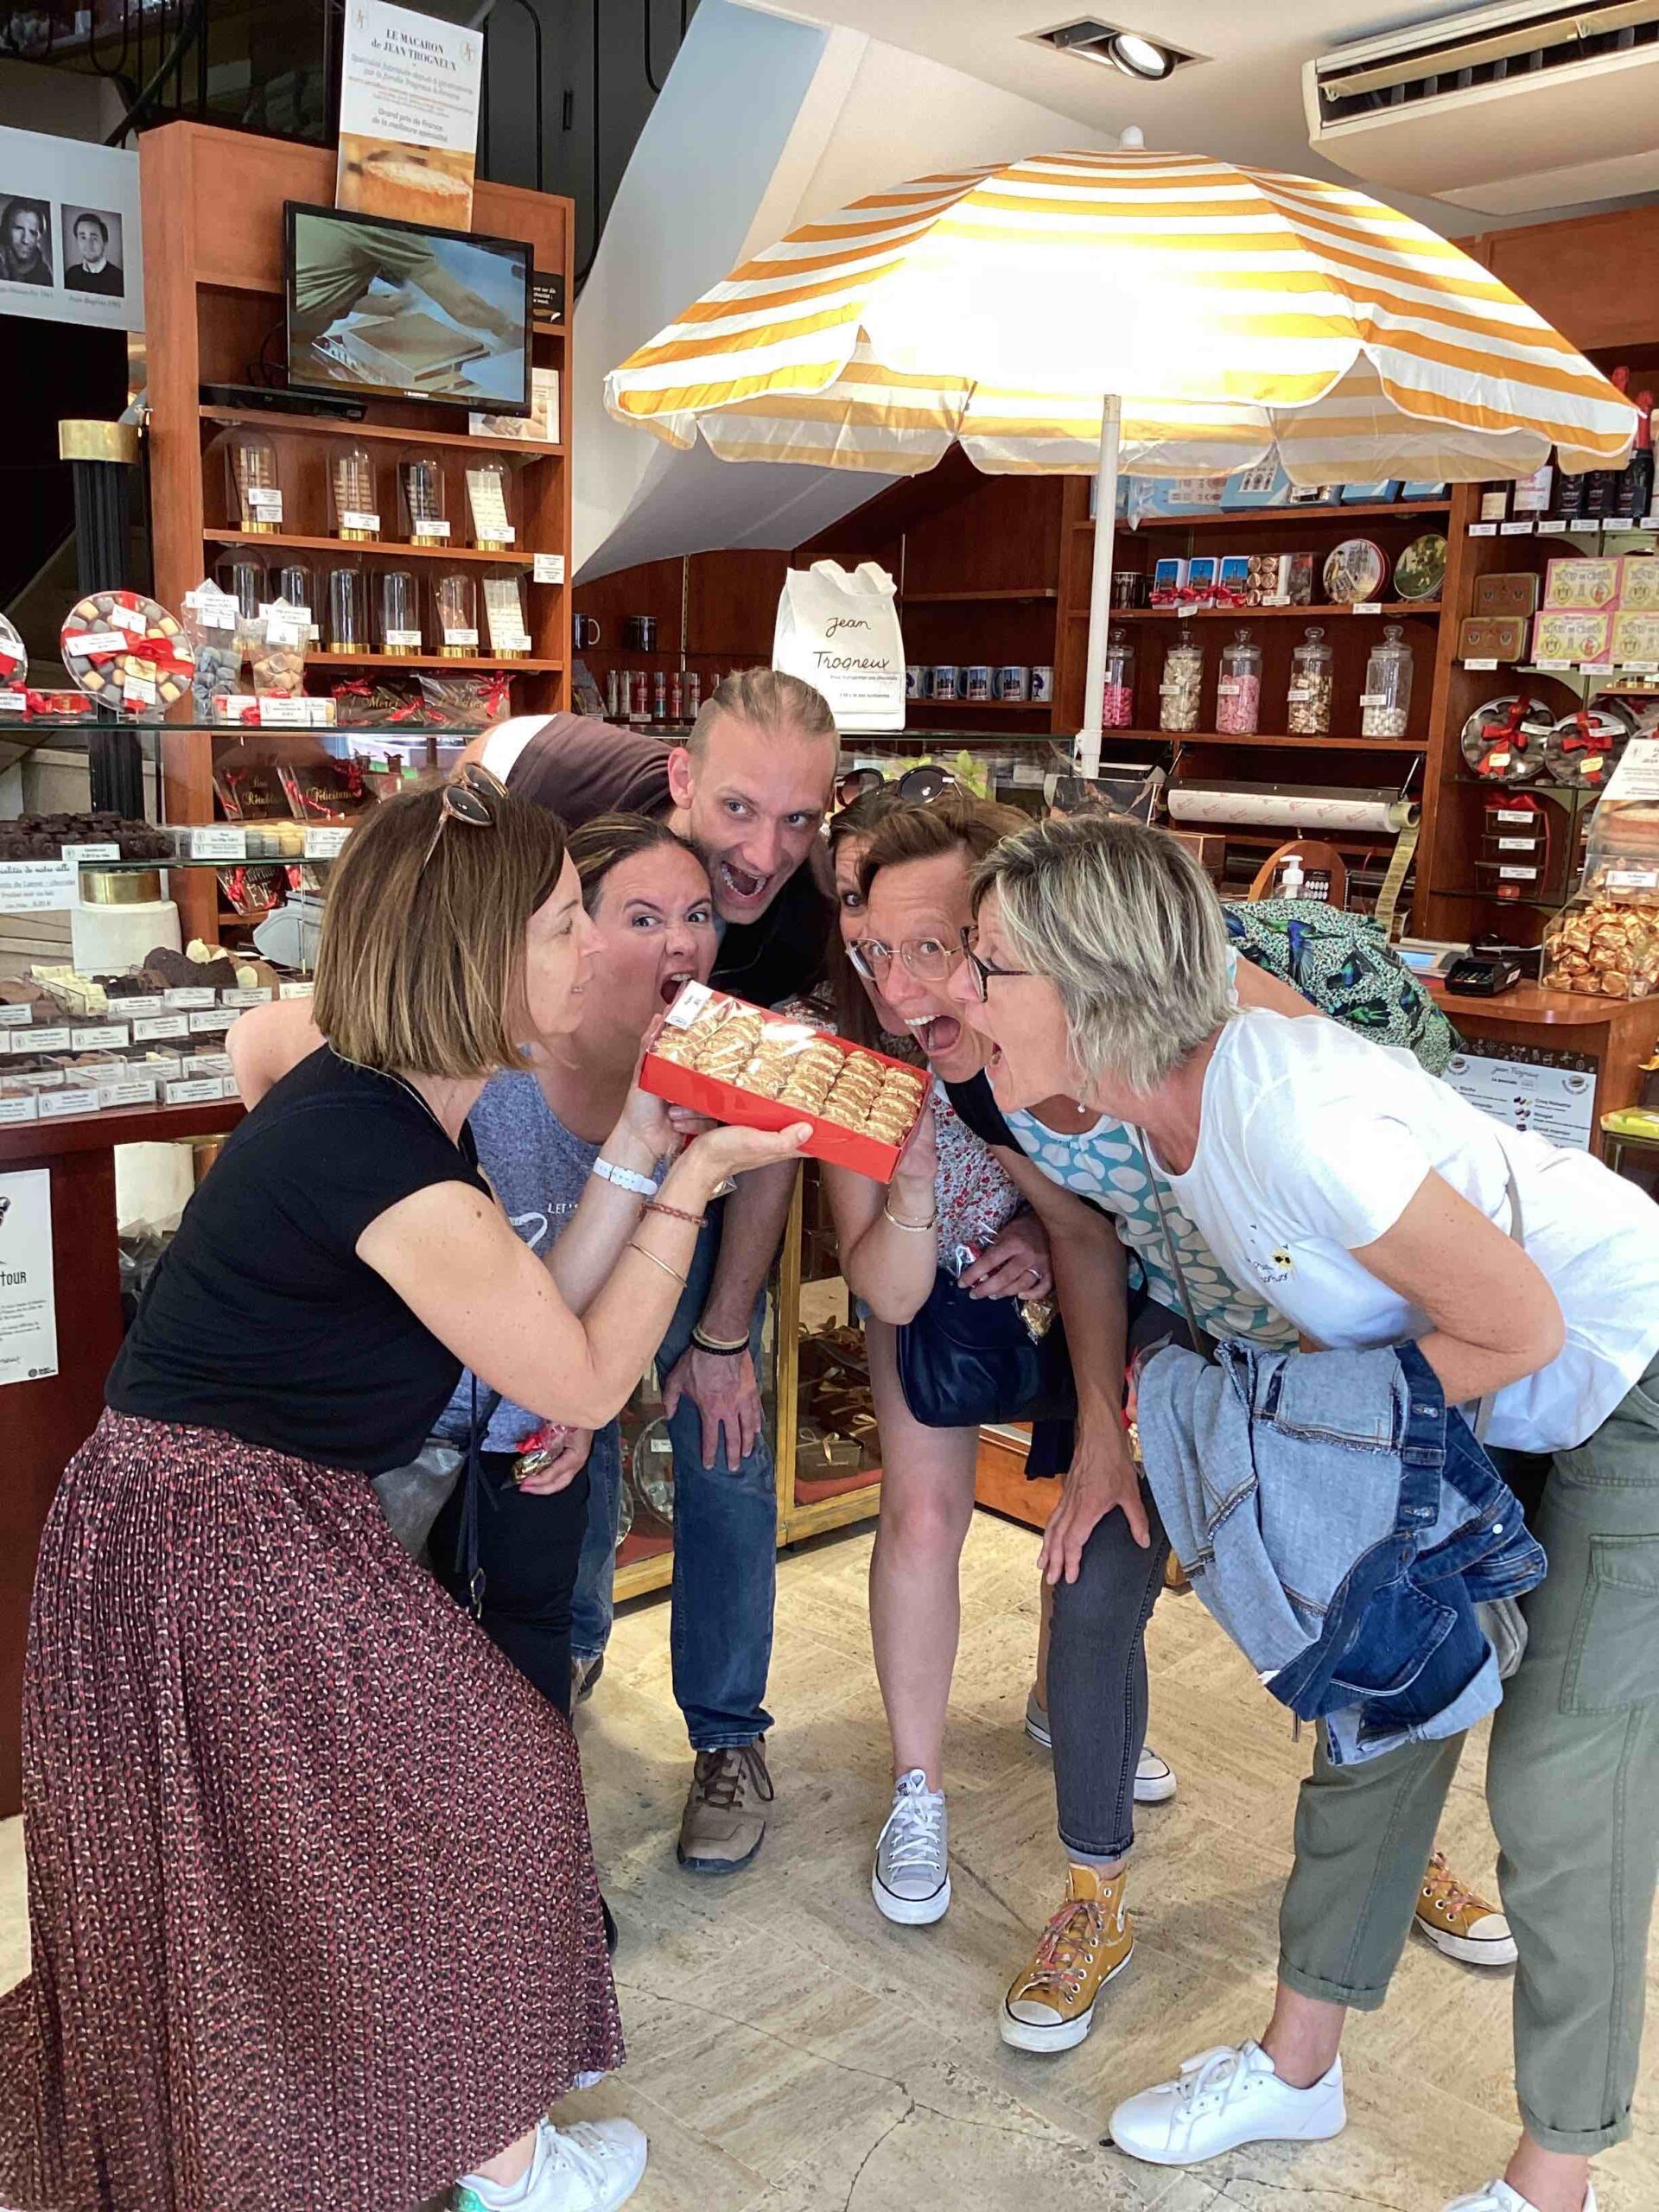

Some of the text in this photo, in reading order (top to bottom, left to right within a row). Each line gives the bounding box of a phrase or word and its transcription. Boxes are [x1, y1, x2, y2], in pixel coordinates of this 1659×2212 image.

[386, 29, 444, 54] LE MACARON
[371, 38, 457, 72] de JEAN TROGNEUX
[812, 651, 891, 672] Trogneux
